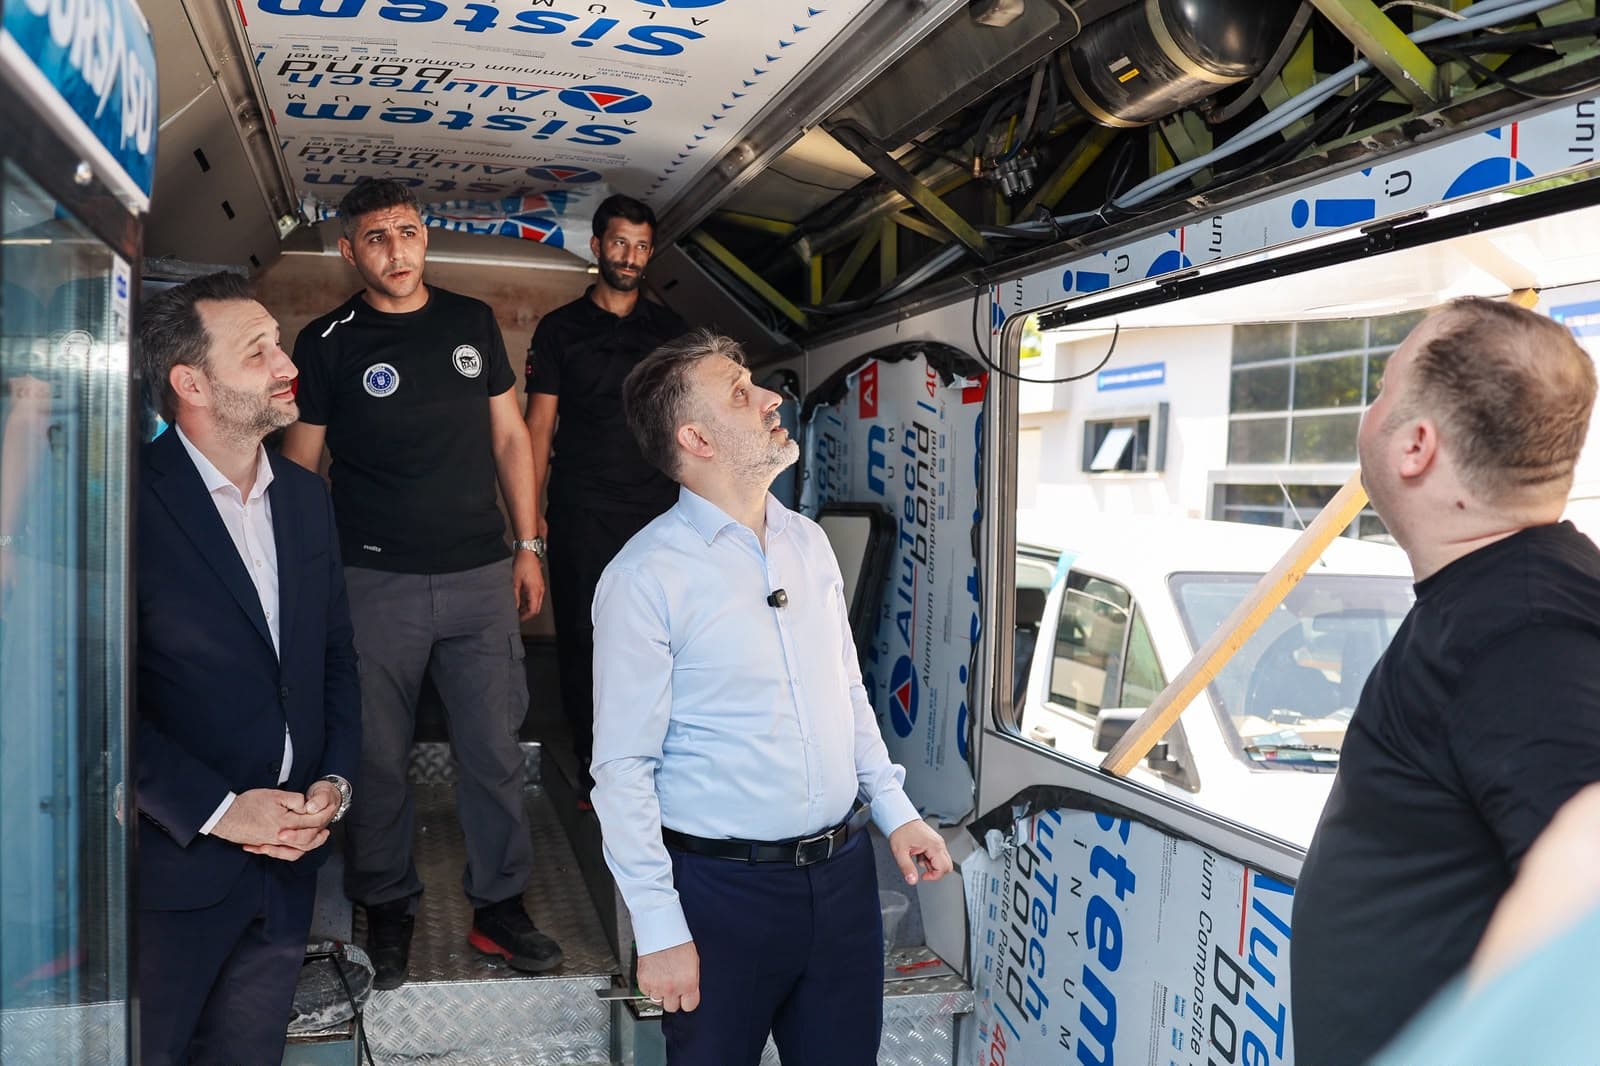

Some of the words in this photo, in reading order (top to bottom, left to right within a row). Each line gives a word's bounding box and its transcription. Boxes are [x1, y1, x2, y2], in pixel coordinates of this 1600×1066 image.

[258, 0, 706, 56] Sistem
[277, 60, 454, 84] bond
[286, 53, 348, 62] Panel
[360, 55, 476, 69] Composite
[485, 64, 598, 81] Aluminium
[288, 73, 550, 101] AluTech
[285, 103, 637, 145] Sistem
[298, 146, 439, 163] bond
[307, 154, 517, 175] AluTech
[910, 420, 929, 566] bond
[896, 428, 917, 648] AluTech
[927, 488, 937, 585] Composite
[924, 592, 934, 688] Aluminium
[1006, 843, 1040, 1022] bond
[995, 929, 1008, 990] Panel
[1190, 910, 1213, 1055] Composite
